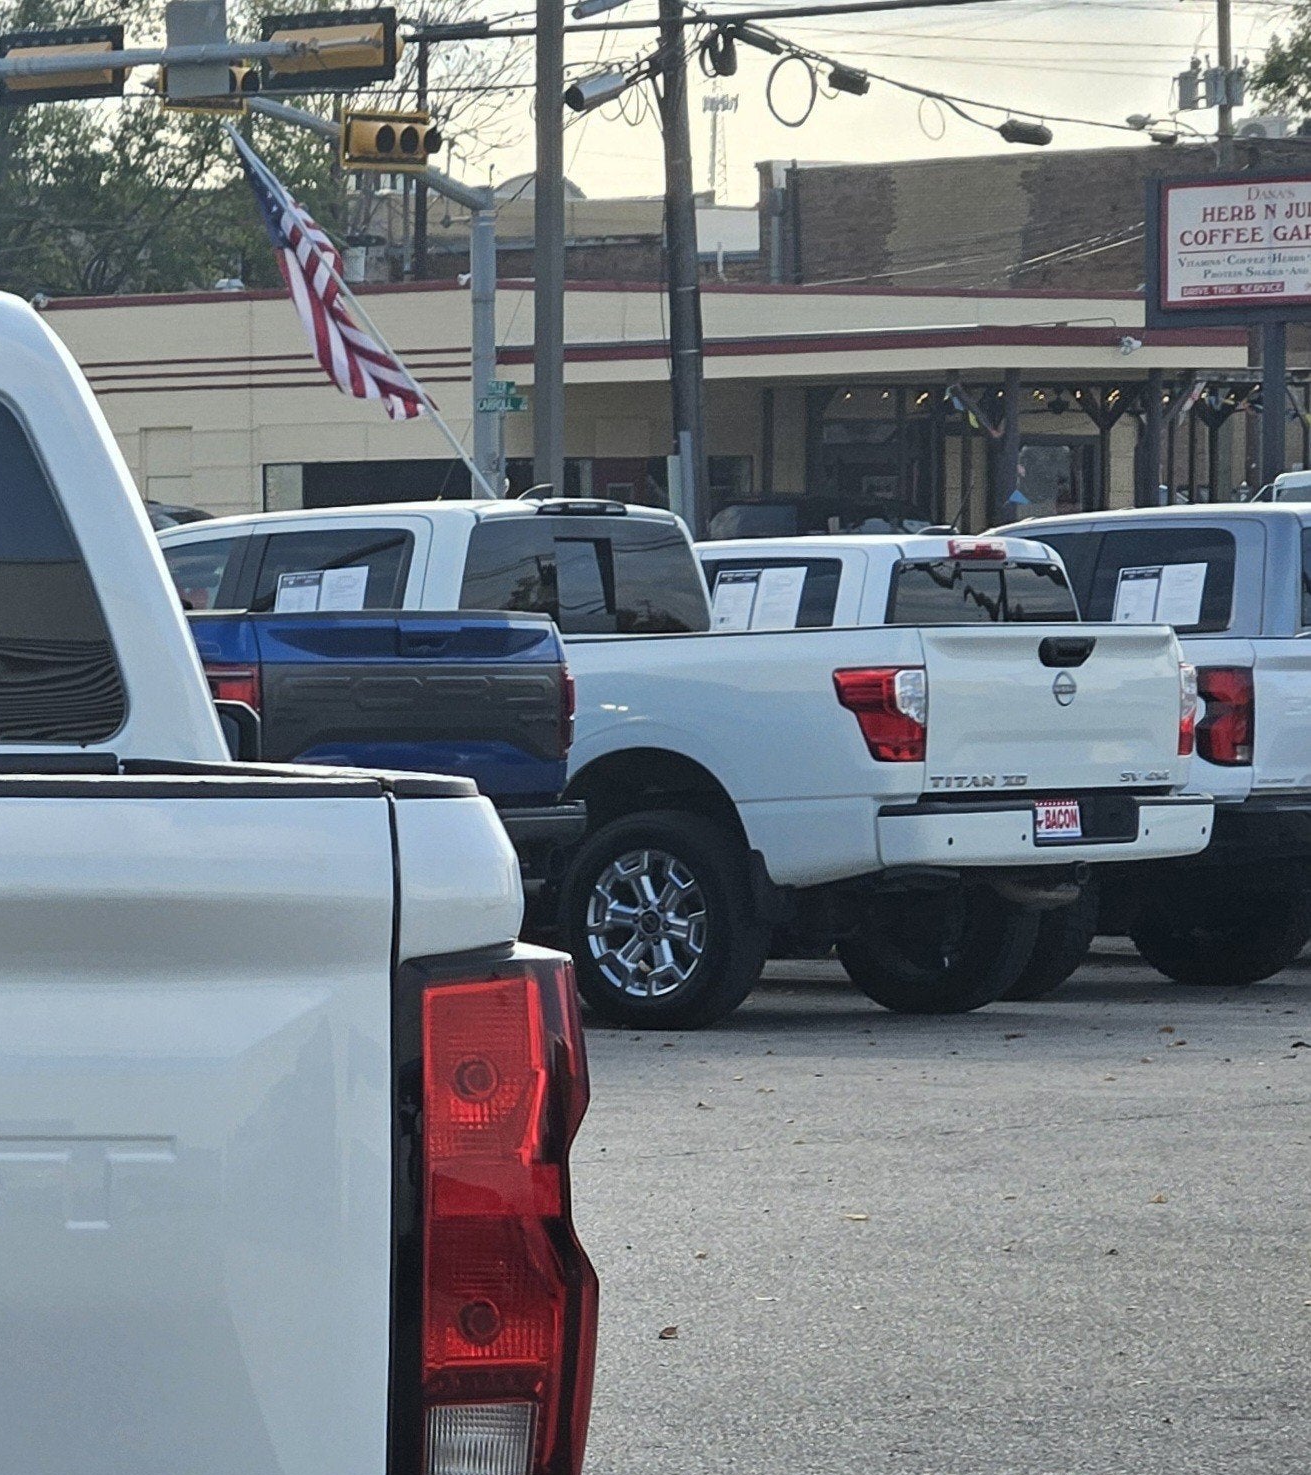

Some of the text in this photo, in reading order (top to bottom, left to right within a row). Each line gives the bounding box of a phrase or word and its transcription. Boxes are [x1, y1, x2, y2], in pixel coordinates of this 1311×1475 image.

[1202, 205, 1256, 223] HERB
[1264, 203, 1276, 220] N
[1179, 227, 1264, 246] COFFEE
[929, 775, 996, 788] TITAN
[1045, 809, 1078, 830] BACON
